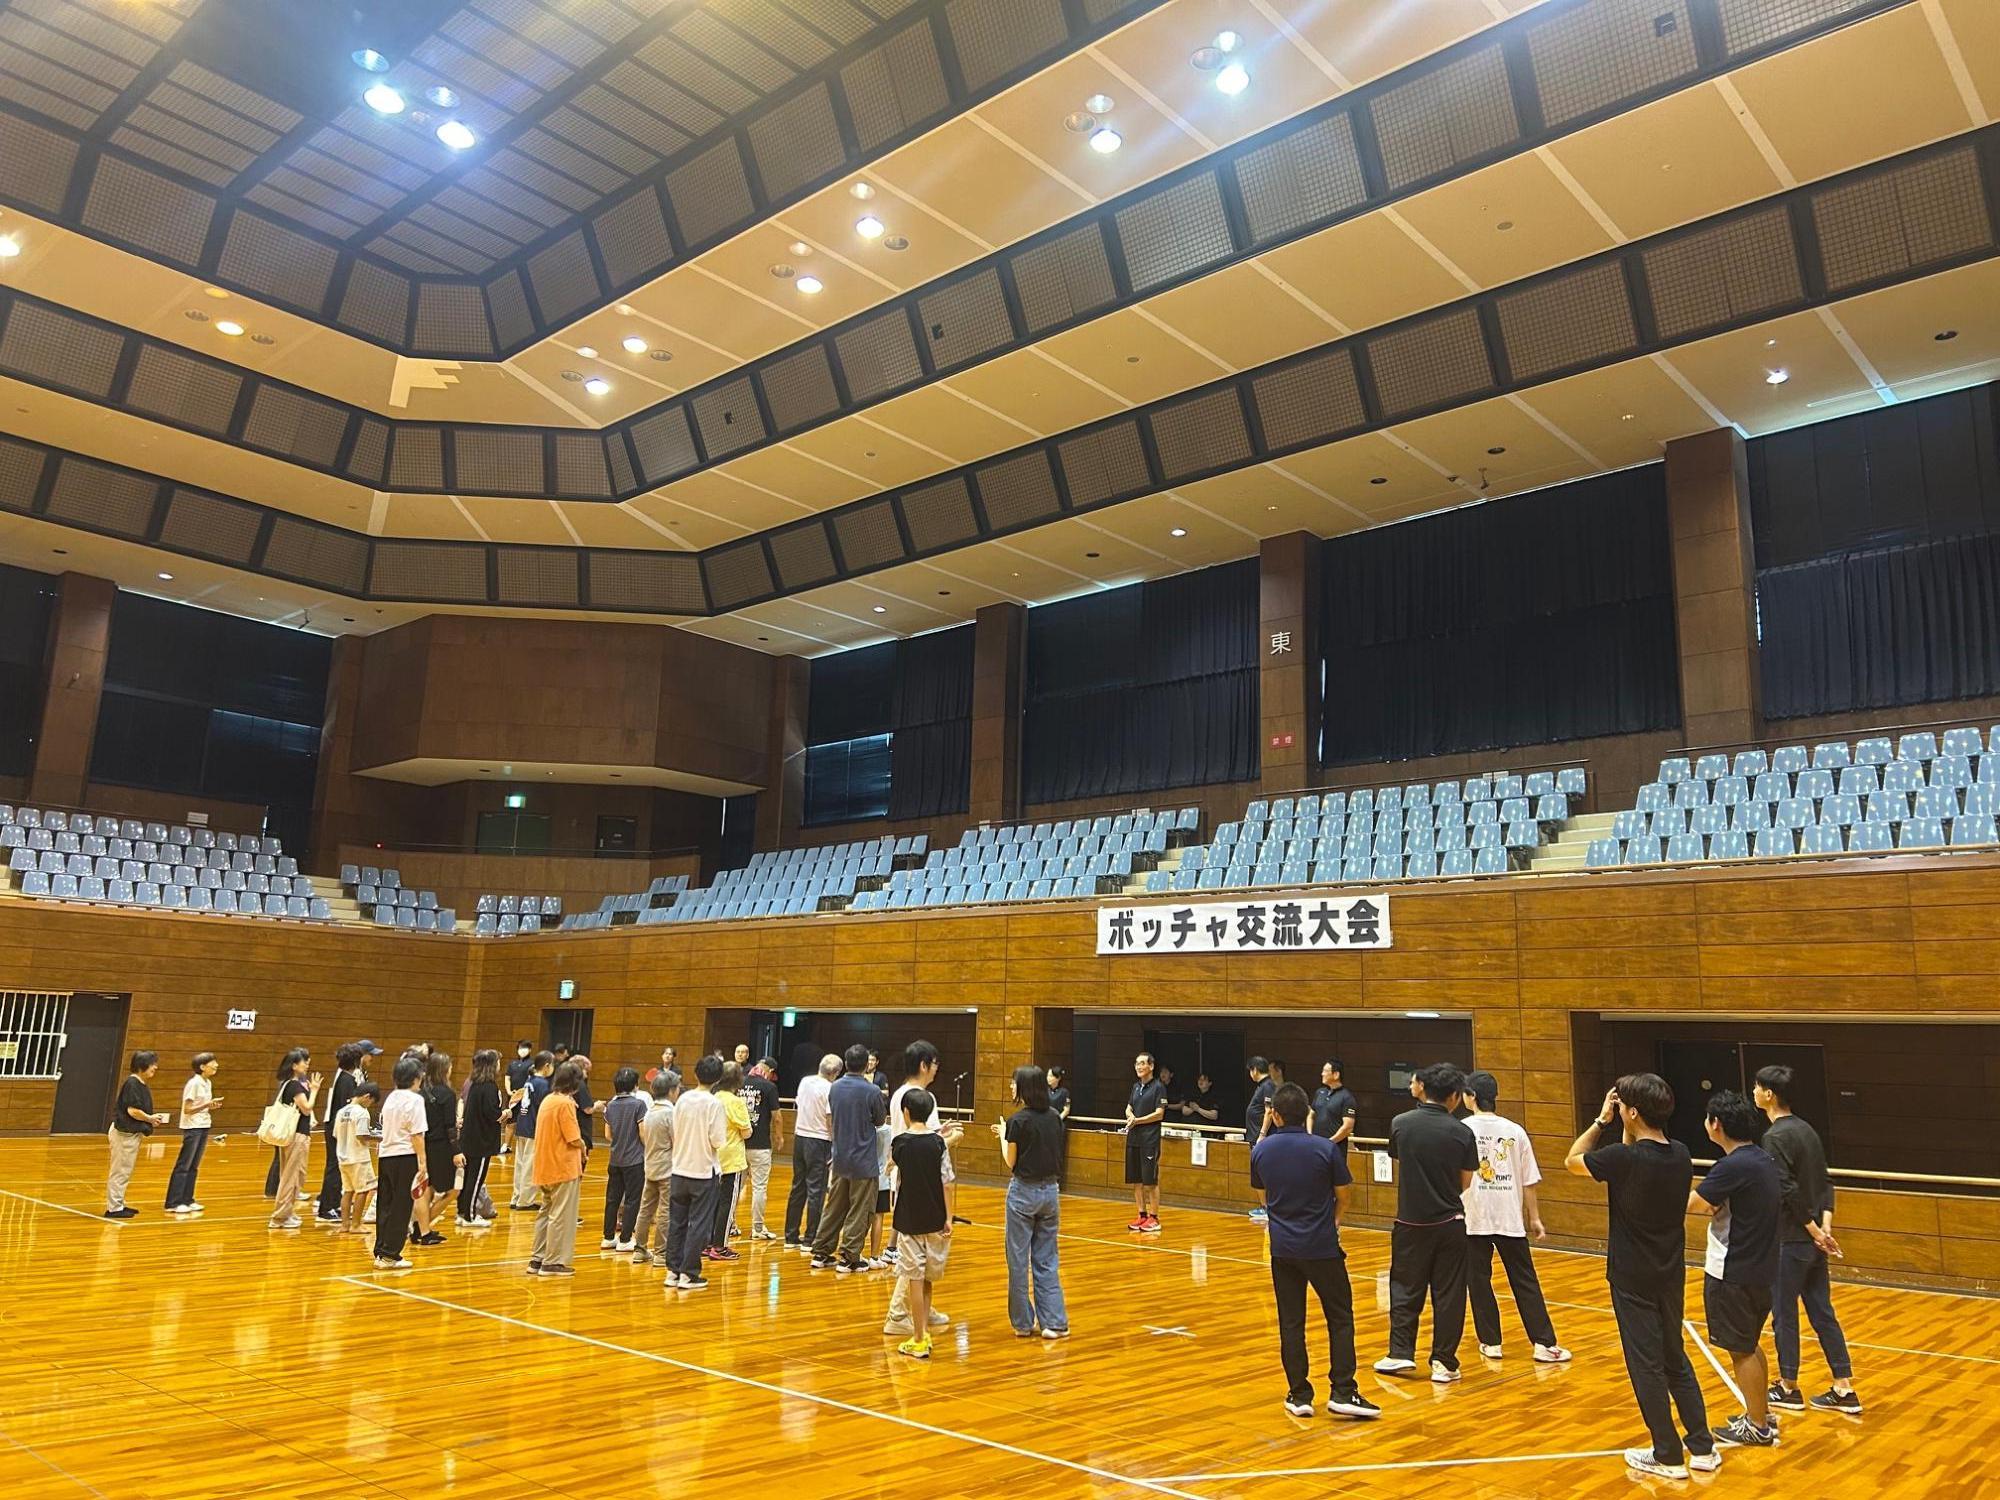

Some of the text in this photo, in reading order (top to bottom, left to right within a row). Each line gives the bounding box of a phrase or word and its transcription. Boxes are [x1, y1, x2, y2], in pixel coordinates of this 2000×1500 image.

[1270, 631, 1292, 655] 東
[1108, 899, 1381, 950] ボッチャ交流大会
[230, 1013, 254, 1027] Aコート
